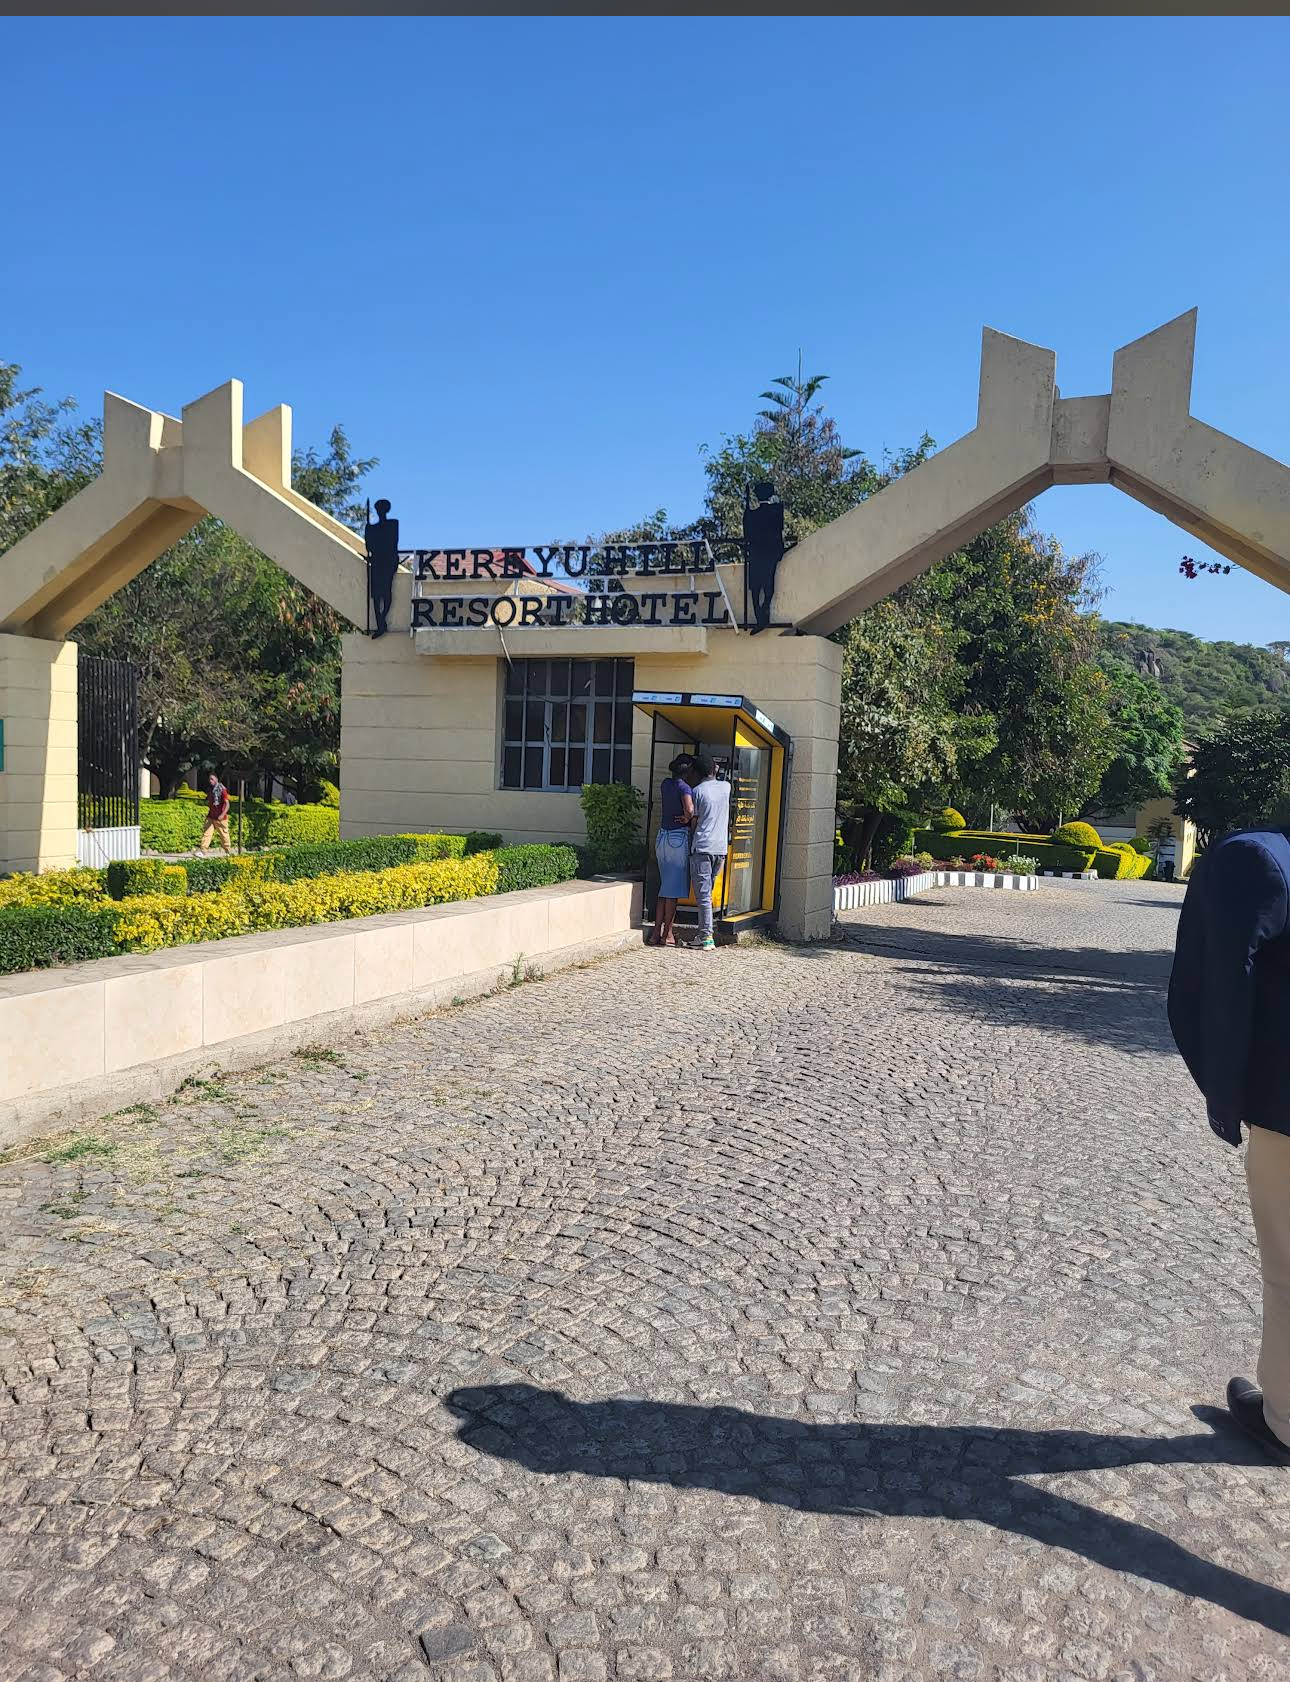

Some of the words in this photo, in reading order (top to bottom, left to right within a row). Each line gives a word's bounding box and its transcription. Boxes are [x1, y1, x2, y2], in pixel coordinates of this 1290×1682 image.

[415, 546, 590, 580] KEREYU
[600, 541, 716, 576] HILL
[410, 595, 572, 627] RESORT
[583, 592, 729, 625] HOTEL
